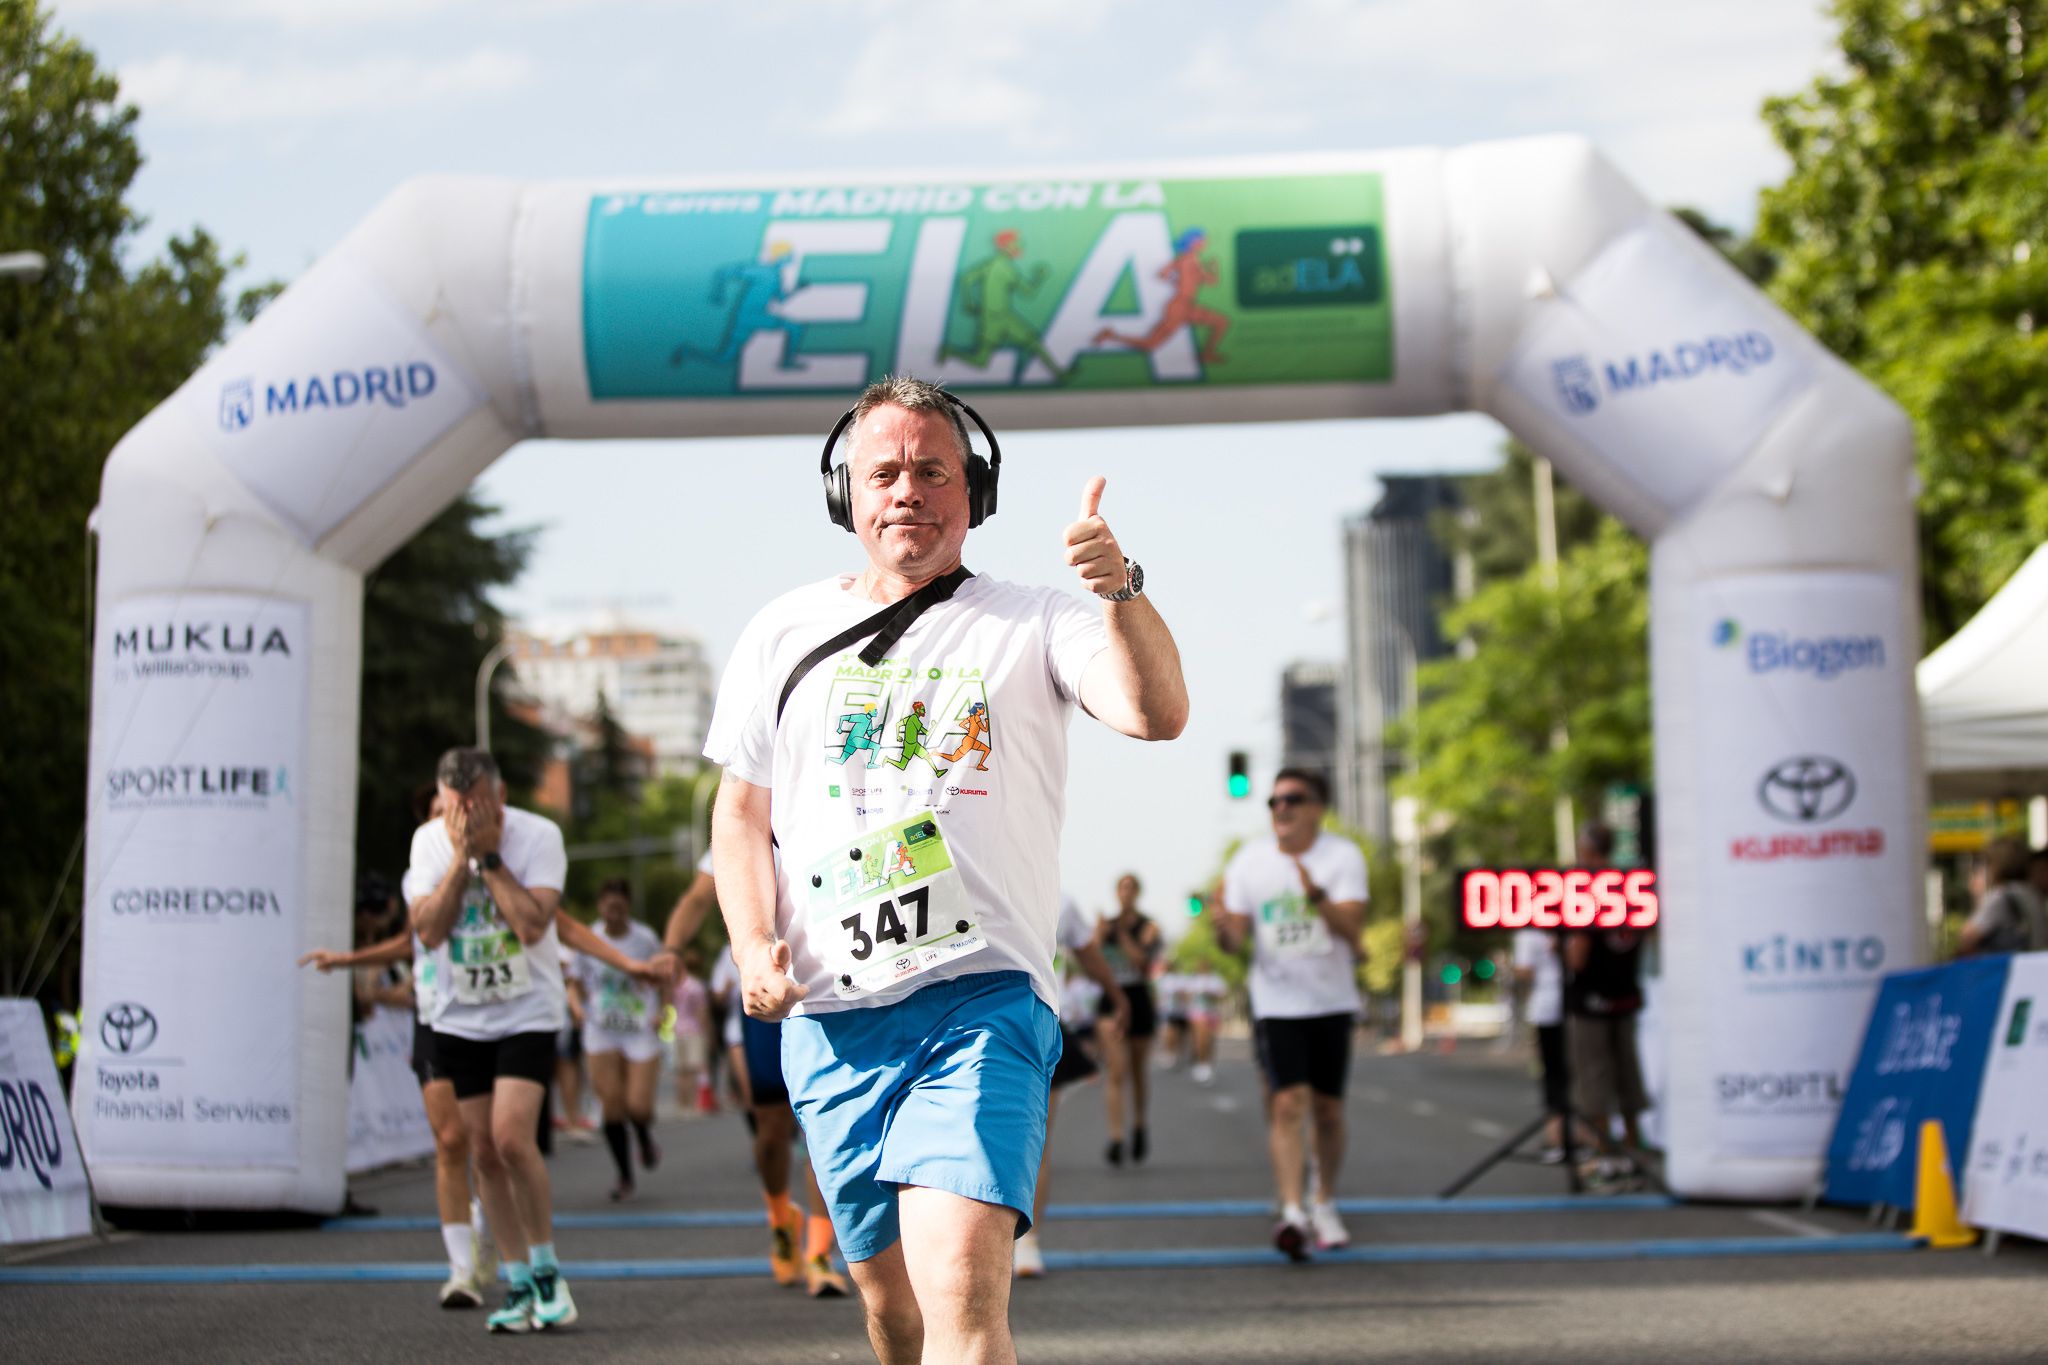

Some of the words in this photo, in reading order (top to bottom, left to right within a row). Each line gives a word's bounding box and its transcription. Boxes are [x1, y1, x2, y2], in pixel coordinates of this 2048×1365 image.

[770, 181, 973, 217] MADRID
[982, 183, 1092, 212] CON
[1101, 178, 1167, 208] LA
[737, 212, 1201, 391] ELA
[1605, 329, 1776, 393] MADRID
[266, 361, 437, 414] MADRID
[113, 622, 292, 658] MUKUA
[1746, 631, 1887, 679] Biogen
[835, 665, 913, 681] MADRD
[958, 667, 981, 678] LA
[824, 678, 992, 751] ELA
[910, 830, 928, 841] adEL
[840, 885, 929, 961] 347
[466, 961, 512, 989] 723
[97, 1066, 159, 1094] Toyota
[94, 1096, 184, 1121] Financial
[195, 1098, 292, 1125] Services
